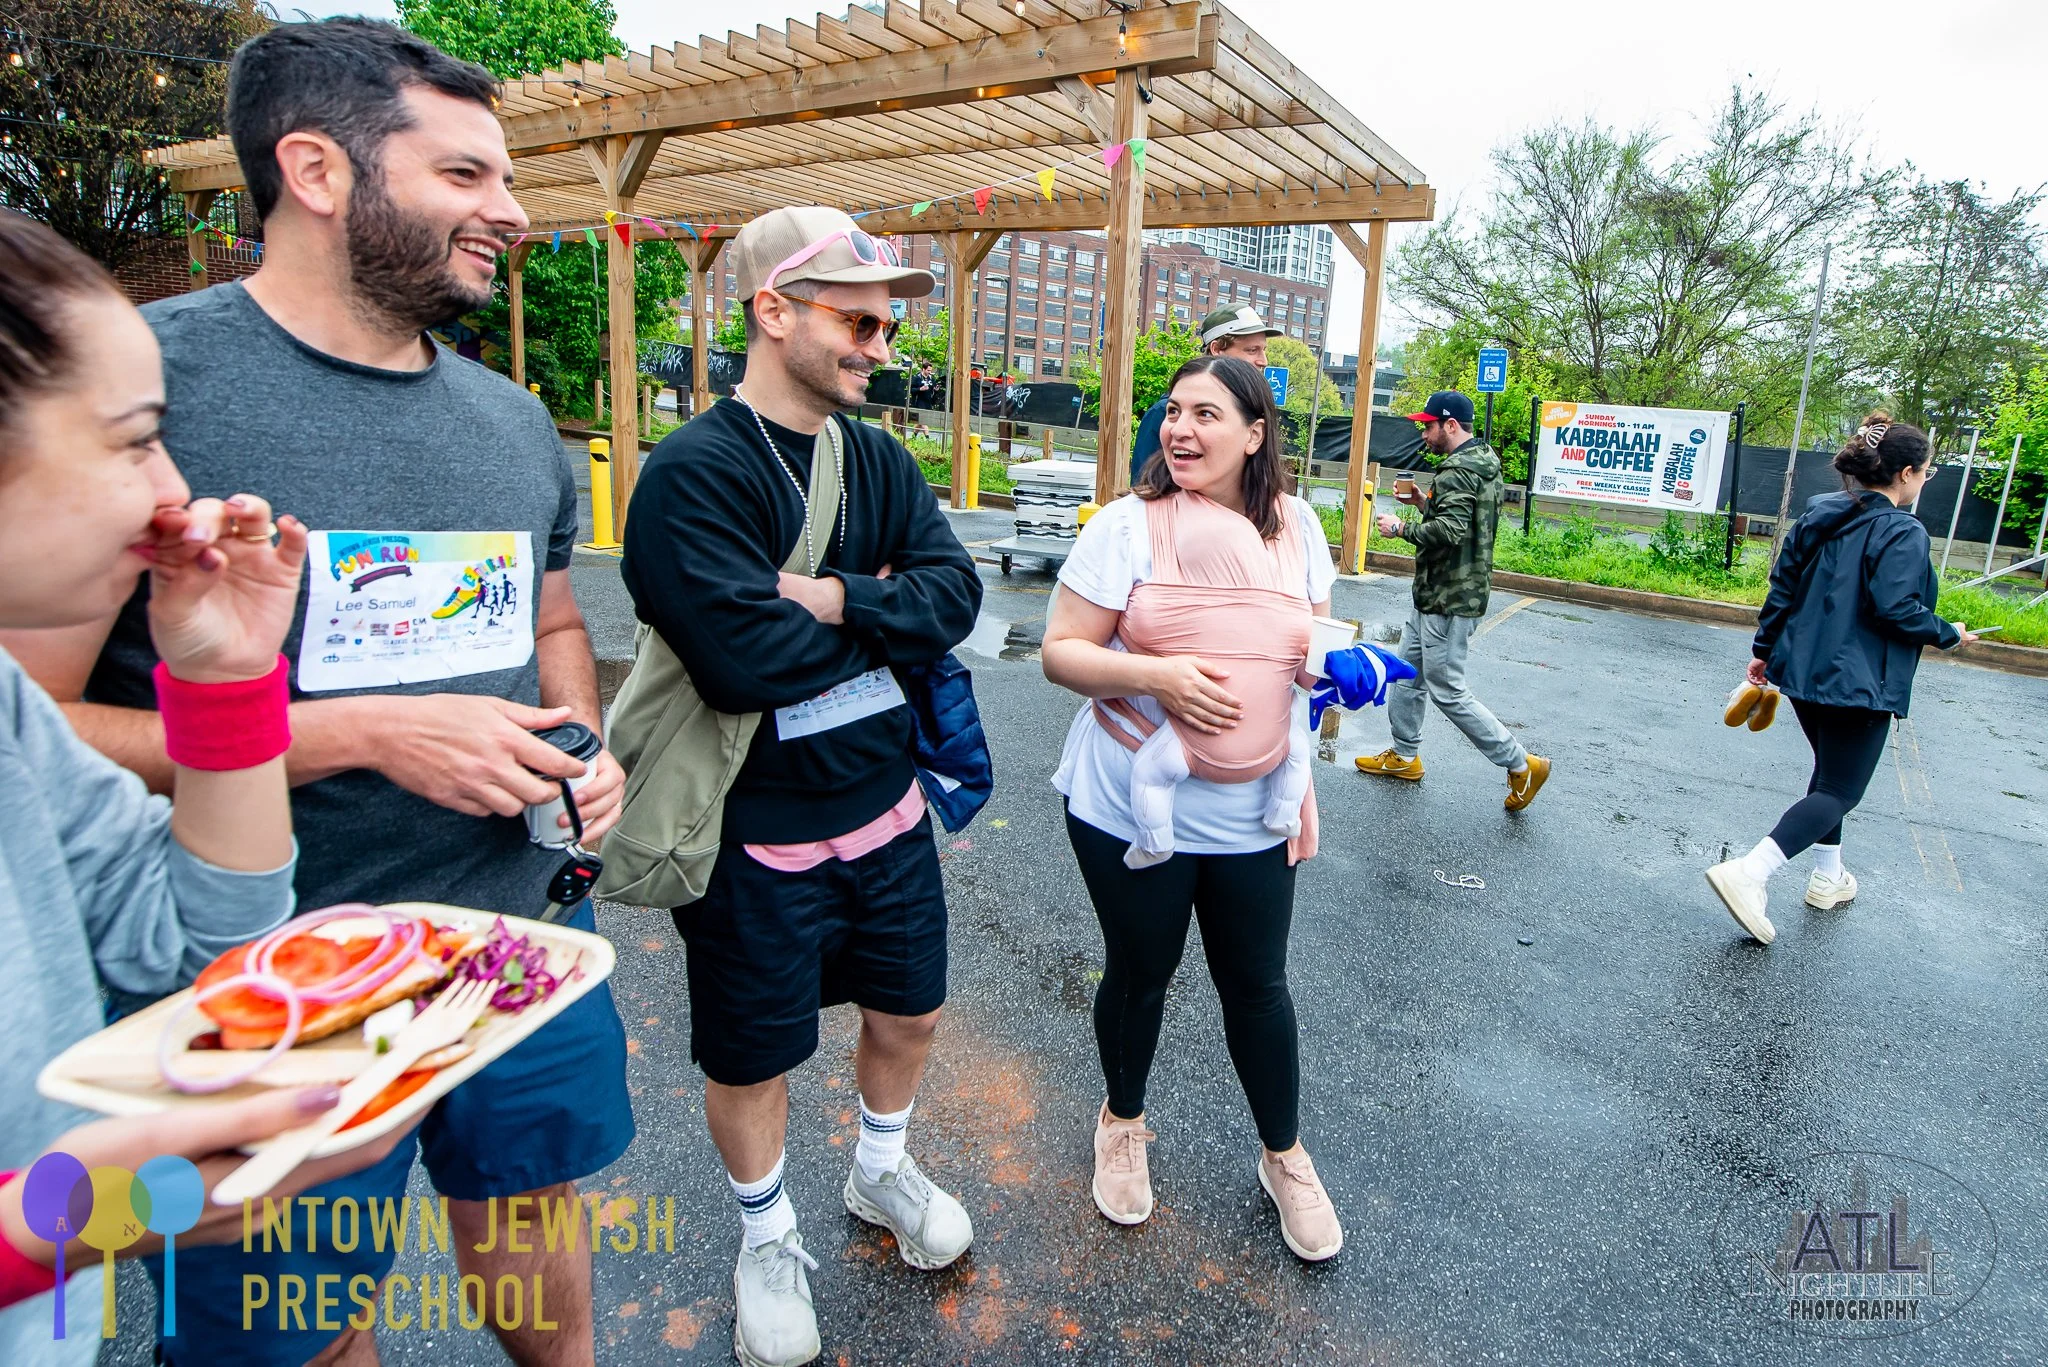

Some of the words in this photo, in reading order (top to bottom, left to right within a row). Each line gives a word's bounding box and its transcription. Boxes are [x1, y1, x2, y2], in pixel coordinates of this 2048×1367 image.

[1578, 420, 1617, 428] MORNINGS
[1584, 414, 1616, 422] SUNDAY
[1555, 426, 1661, 453] KABBALAH
[1561, 447, 1586, 461] AND
[1586, 448, 1656, 473] COFFEE
[1661, 442, 1685, 494] KABBALAH
[1677, 446, 1698, 481] COFFEE
[1594, 481, 1621, 490] WEEKLY
[1623, 484, 1651, 493] CLASSES
[331, 549, 374, 581] FUN
[381, 546, 419, 563] RUN
[336, 600, 363, 612] Lee
[368, 597, 416, 610] Samuel
